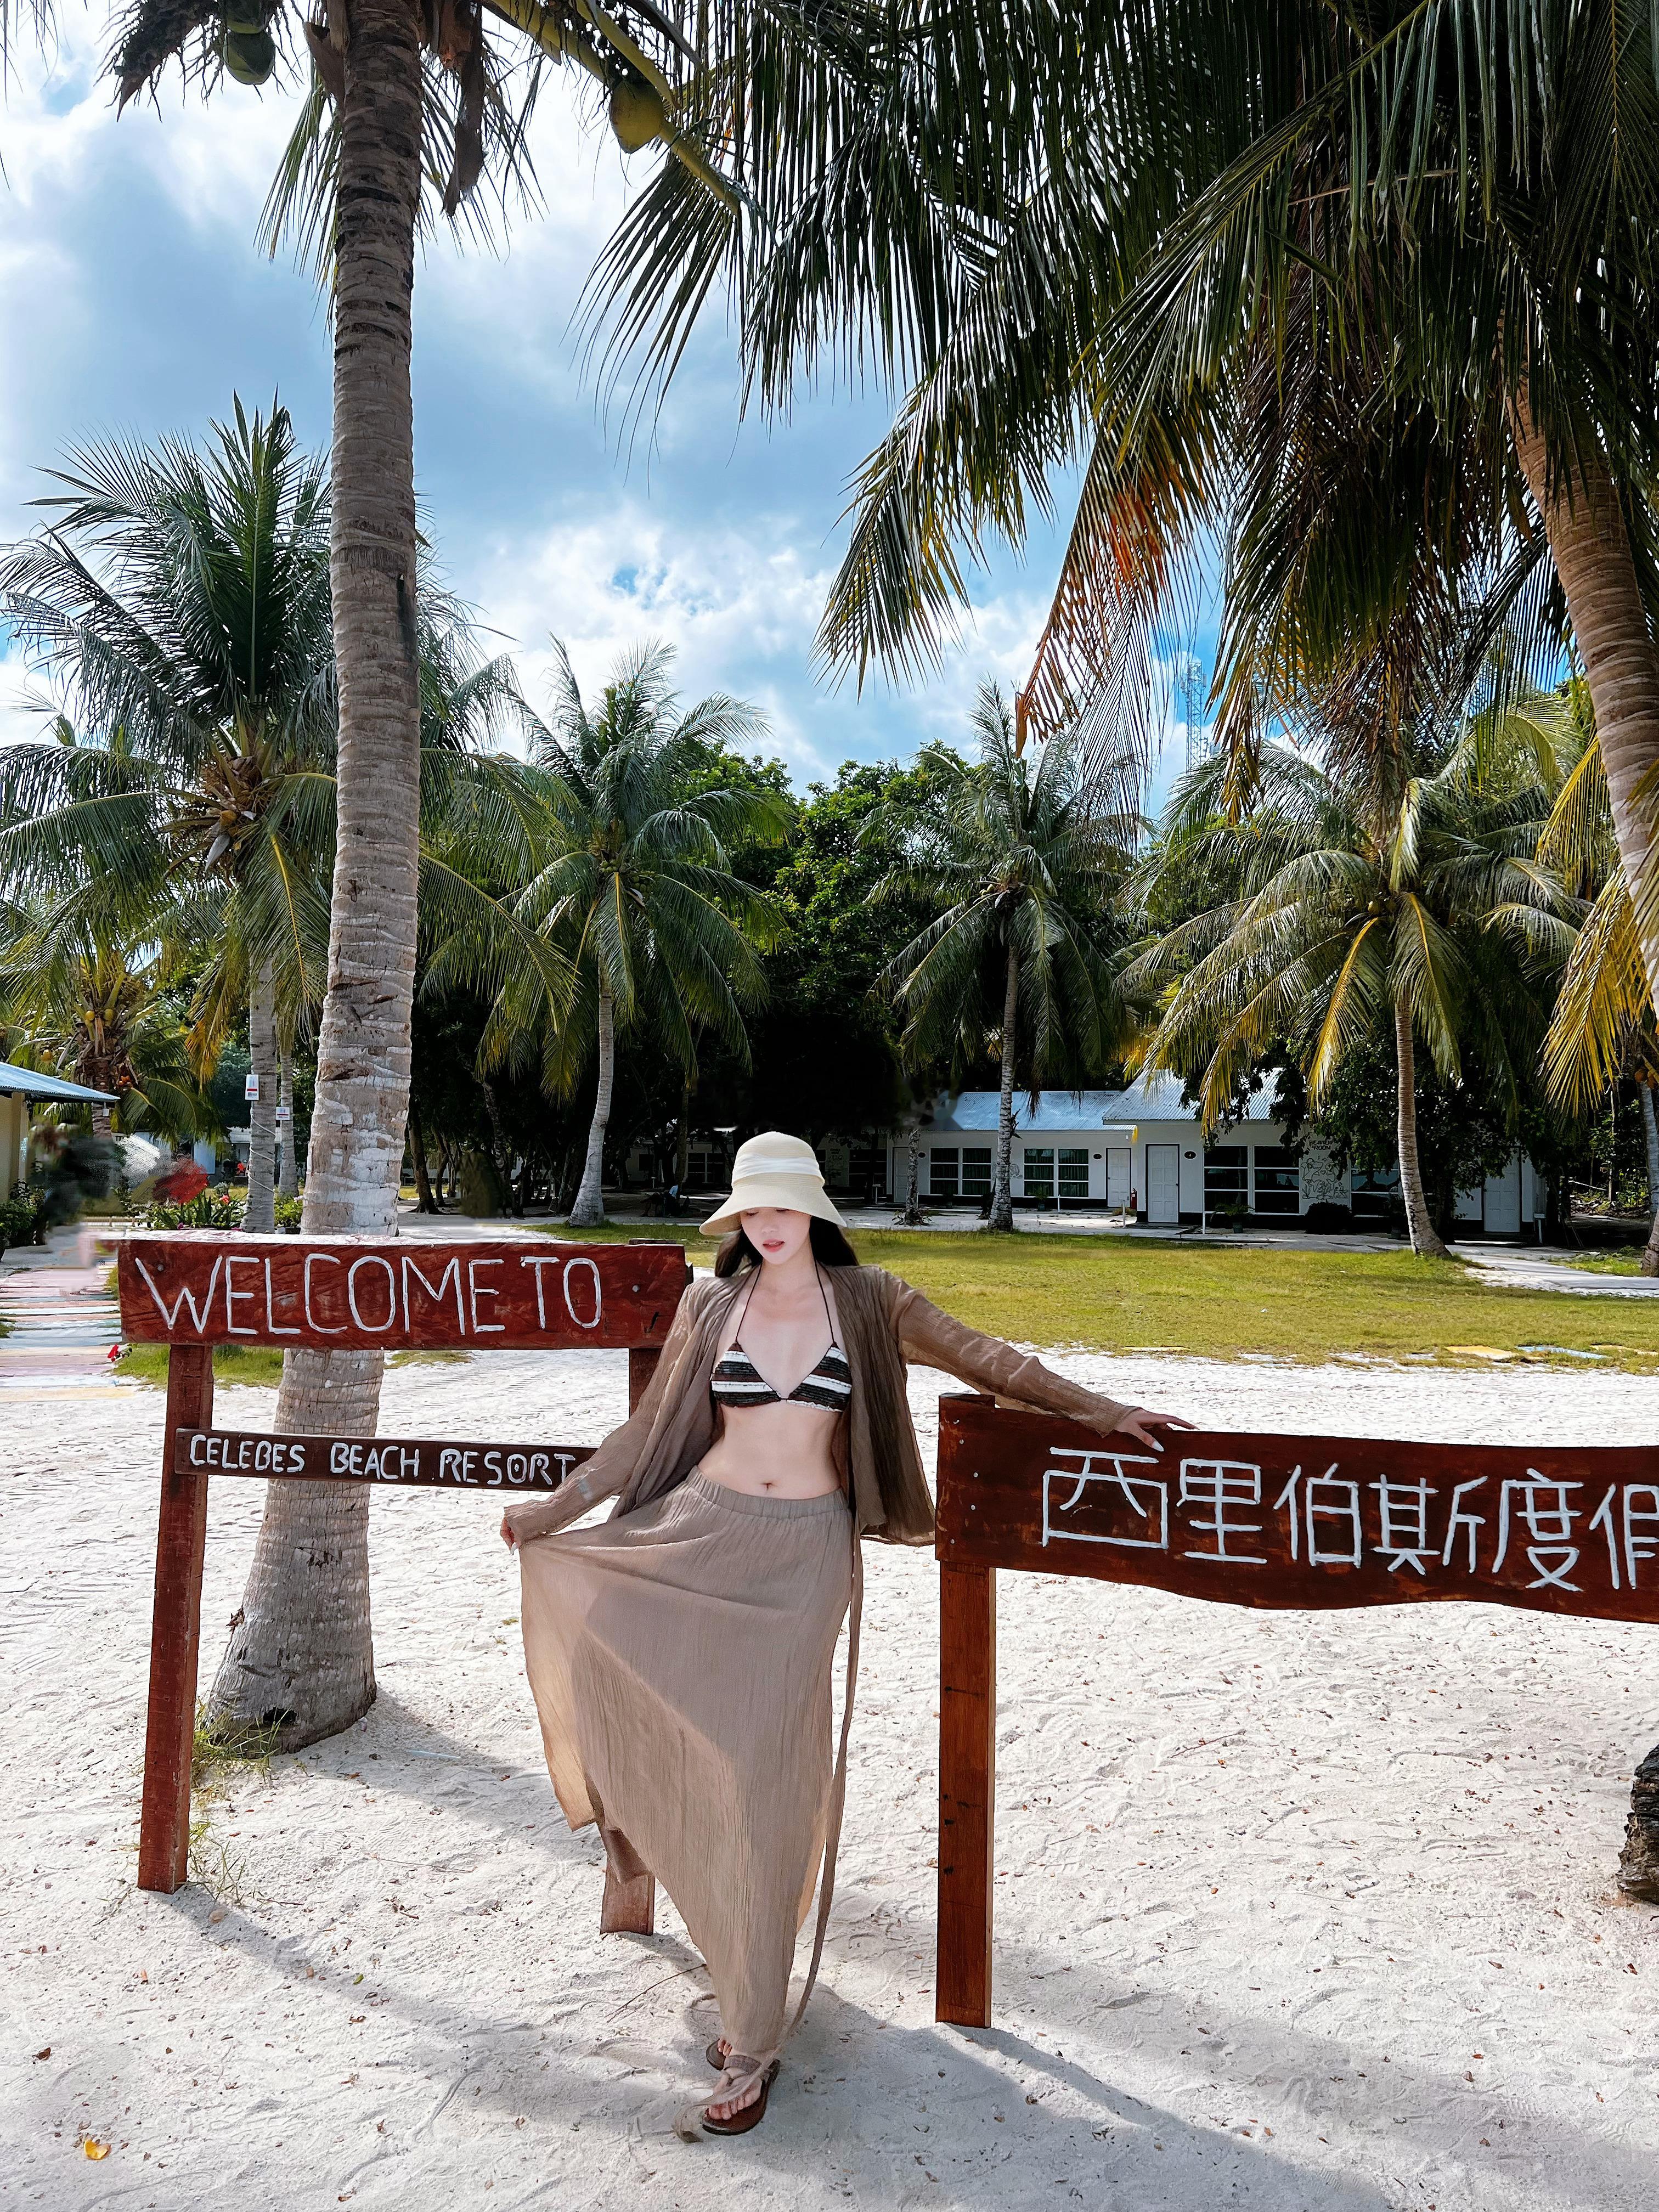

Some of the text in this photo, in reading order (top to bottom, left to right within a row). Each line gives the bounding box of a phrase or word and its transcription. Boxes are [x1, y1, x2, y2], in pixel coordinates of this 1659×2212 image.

[135, 1253, 602, 1335] WELCOME TO
[190, 1434, 576, 1485] CELEBES BEACH RESORT
